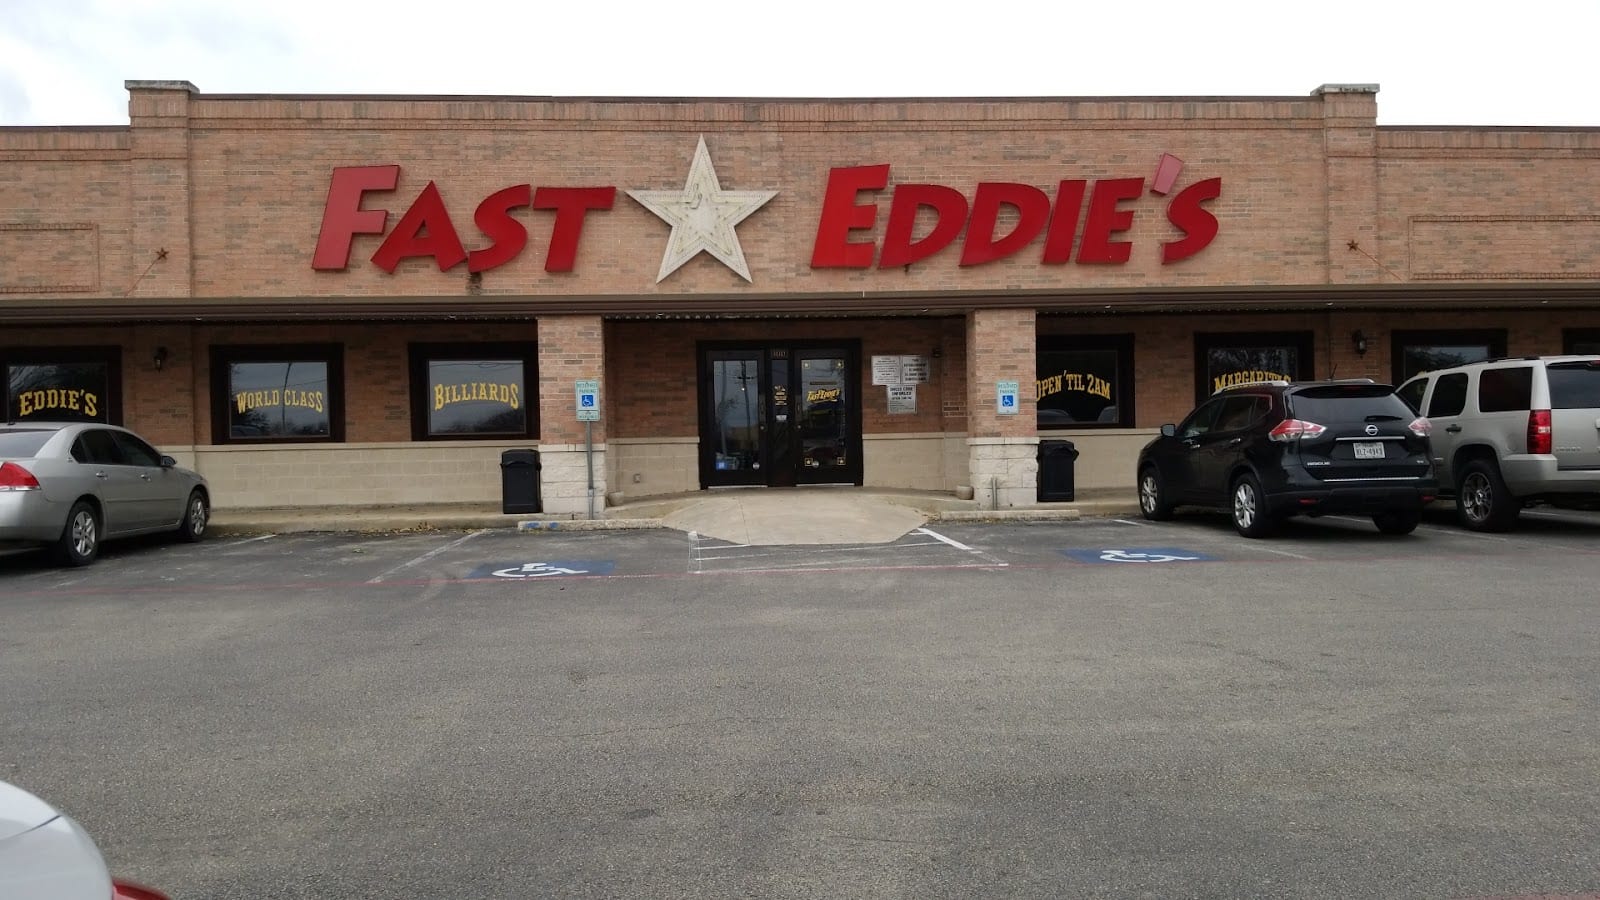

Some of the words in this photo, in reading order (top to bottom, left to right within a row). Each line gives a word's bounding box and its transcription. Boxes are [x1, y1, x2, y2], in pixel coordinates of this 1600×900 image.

[312, 165, 616, 274] FAST
[810, 152, 1221, 270] EDDIE'S
[236, 389, 280, 415] WORLD
[284, 389, 323, 413] CLASS
[434, 382, 519, 411] BILLIARDS
[1036, 375, 1062, 402] OPEN
[1087, 373, 1111, 401] 2AM
[20, 389, 97, 417] EDDIE'S
